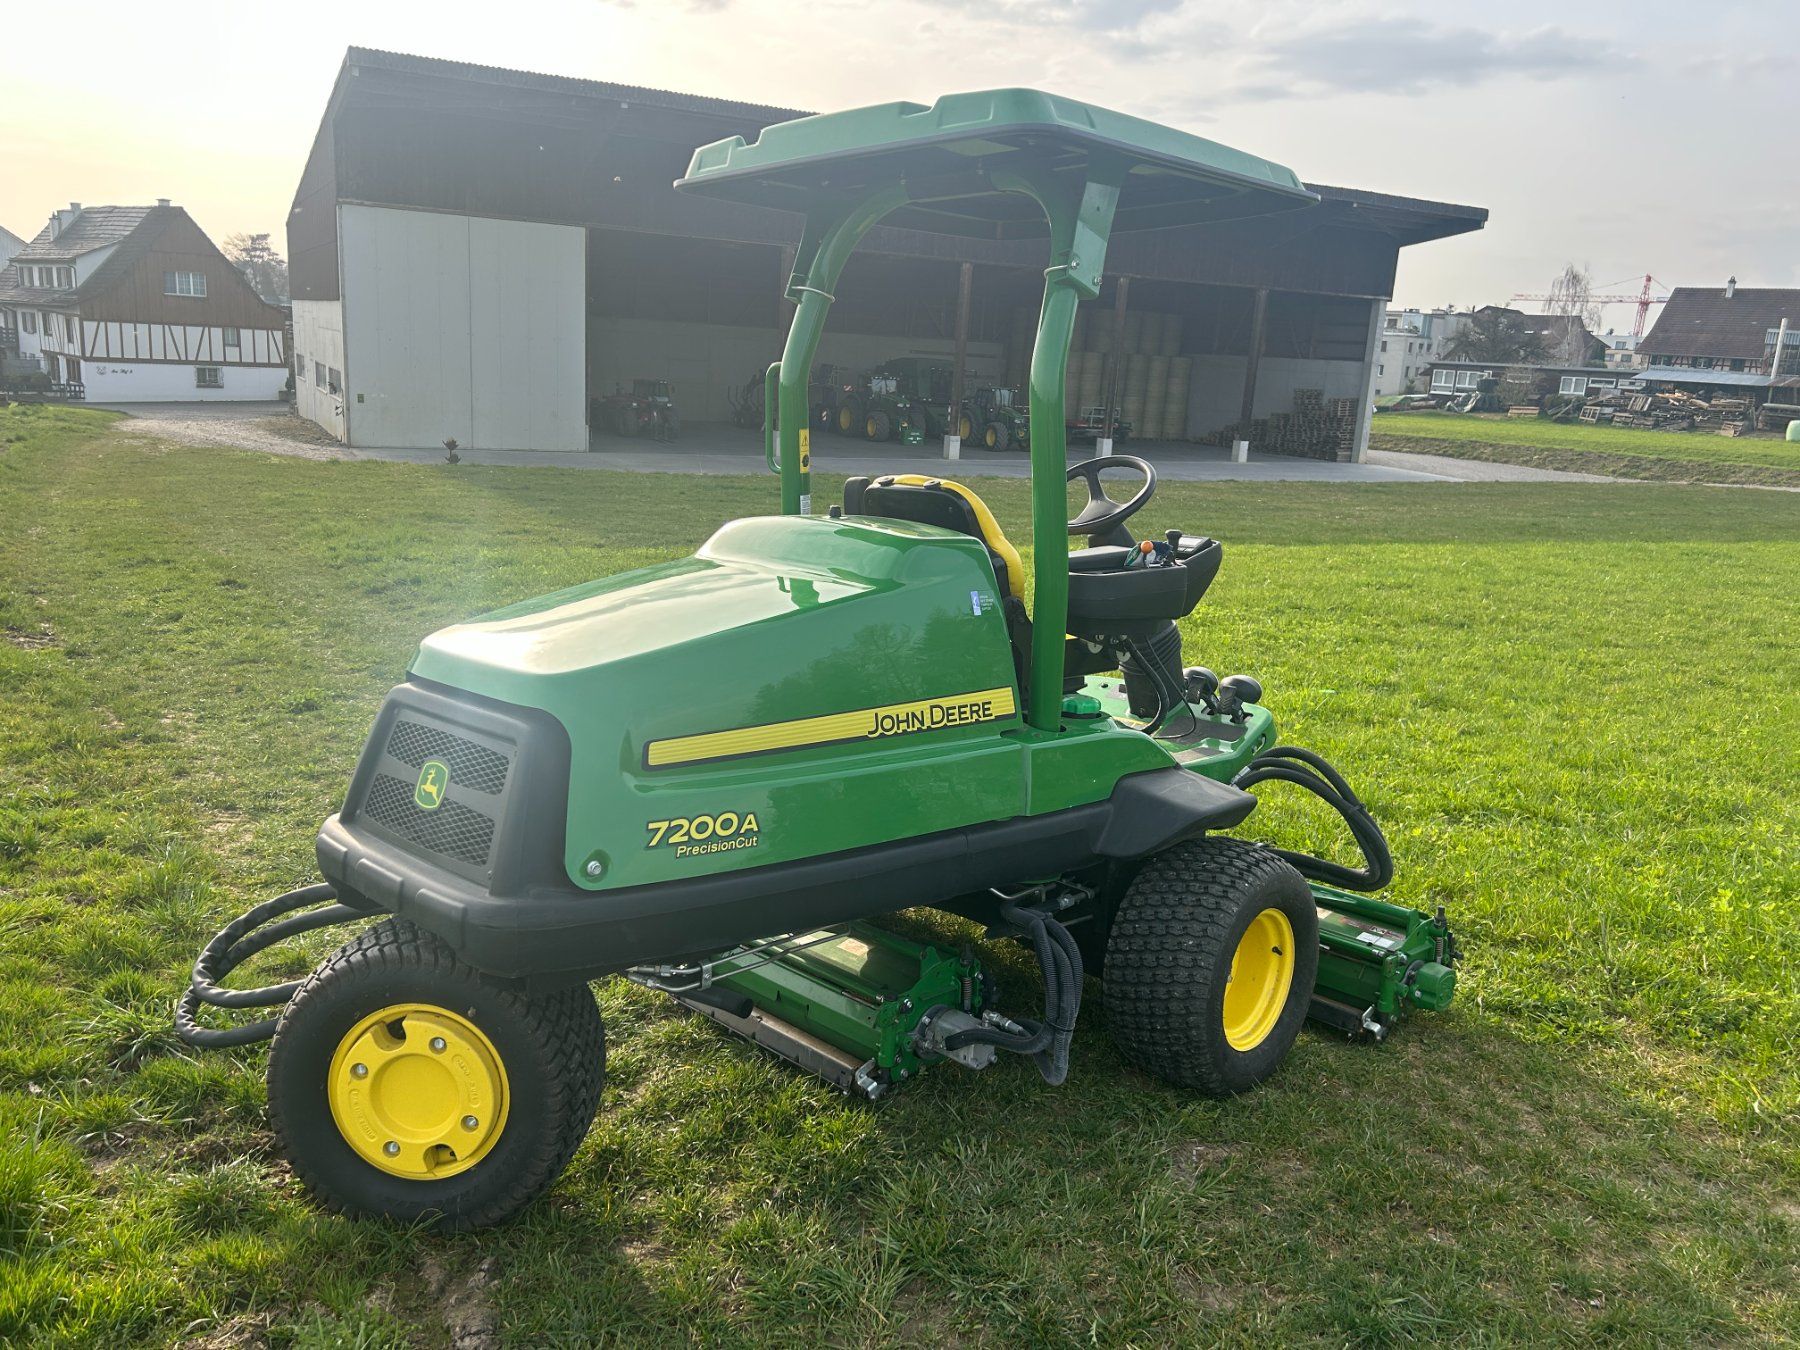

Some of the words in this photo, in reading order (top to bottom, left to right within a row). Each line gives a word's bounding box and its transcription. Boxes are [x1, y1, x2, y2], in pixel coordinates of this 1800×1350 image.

[867, 710, 926, 736] JOHN
[929, 700, 994, 727] DEERE
[647, 811, 759, 847] 7200A
[676, 836, 758, 858] PrecisionCut
